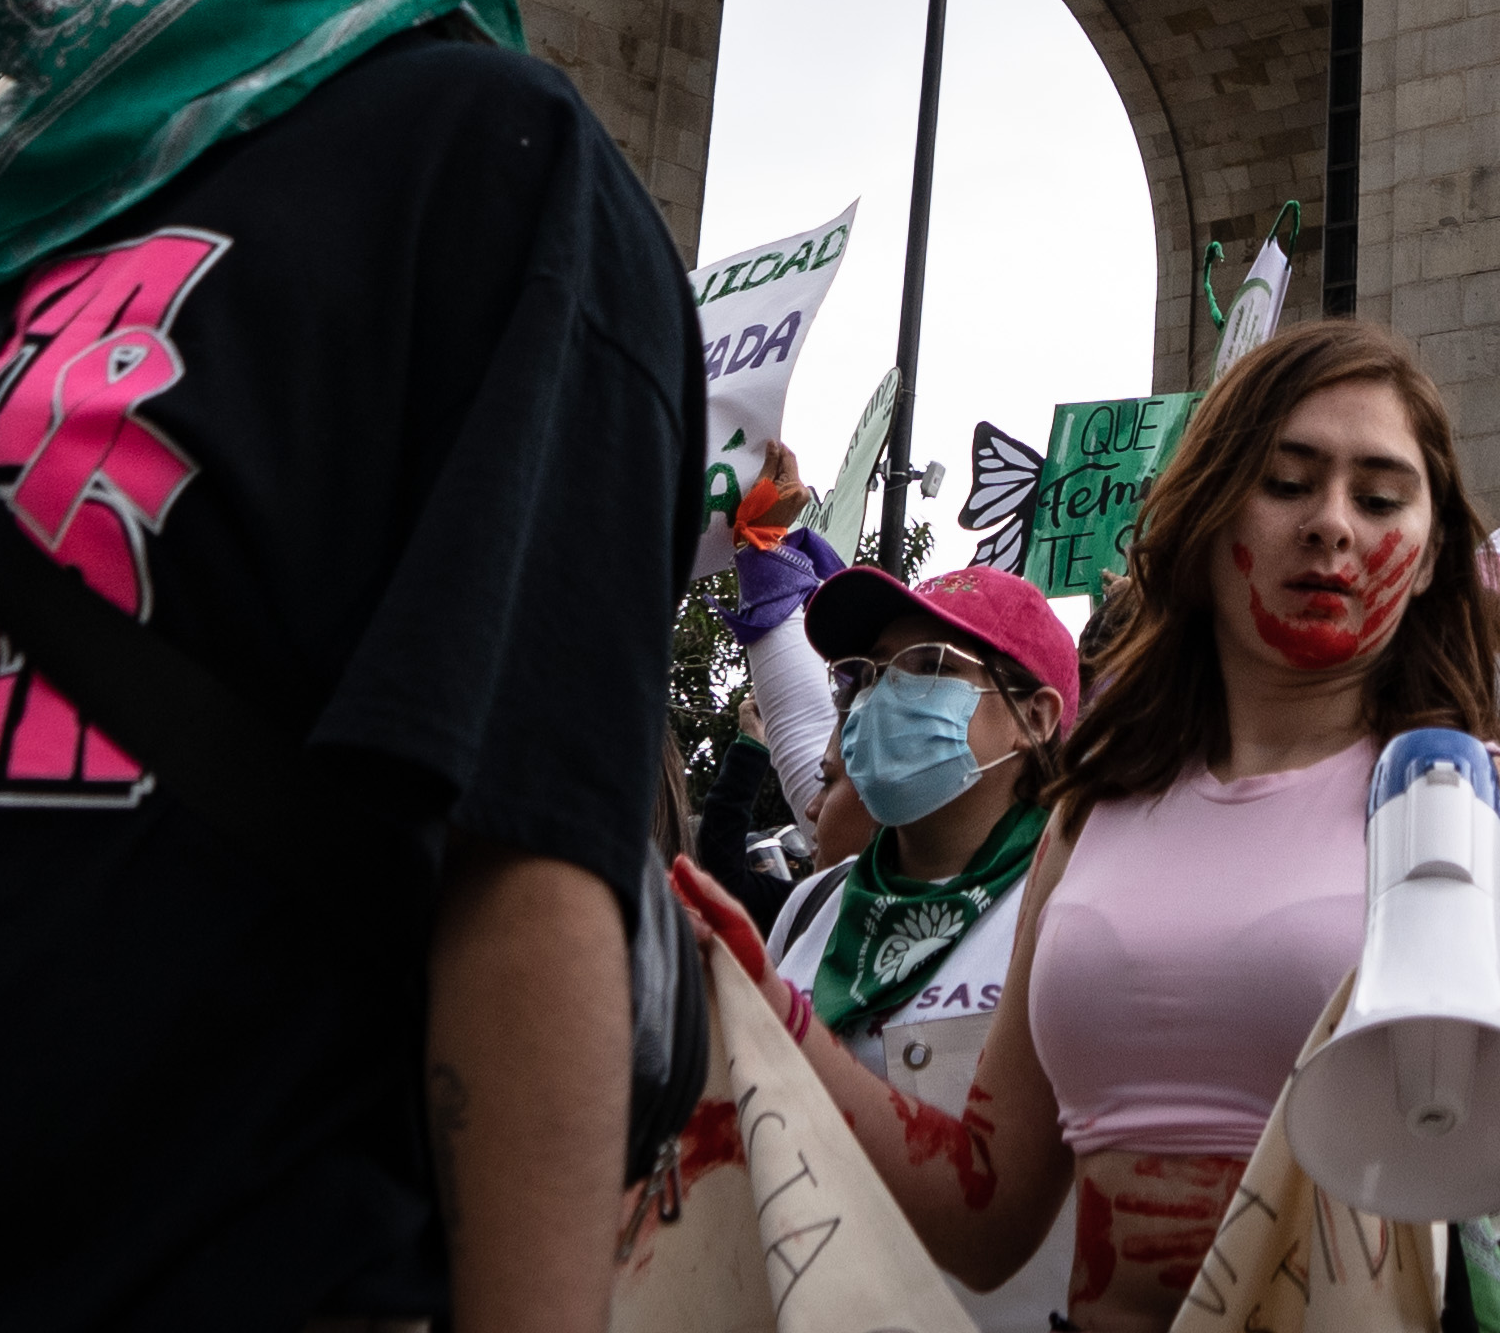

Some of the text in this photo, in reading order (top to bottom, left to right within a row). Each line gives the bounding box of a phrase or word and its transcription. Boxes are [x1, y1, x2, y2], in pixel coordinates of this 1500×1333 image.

[703, 310, 802, 383] ADA
[1080, 400, 1165, 457] QUE
[1038, 532, 1096, 592] TE
